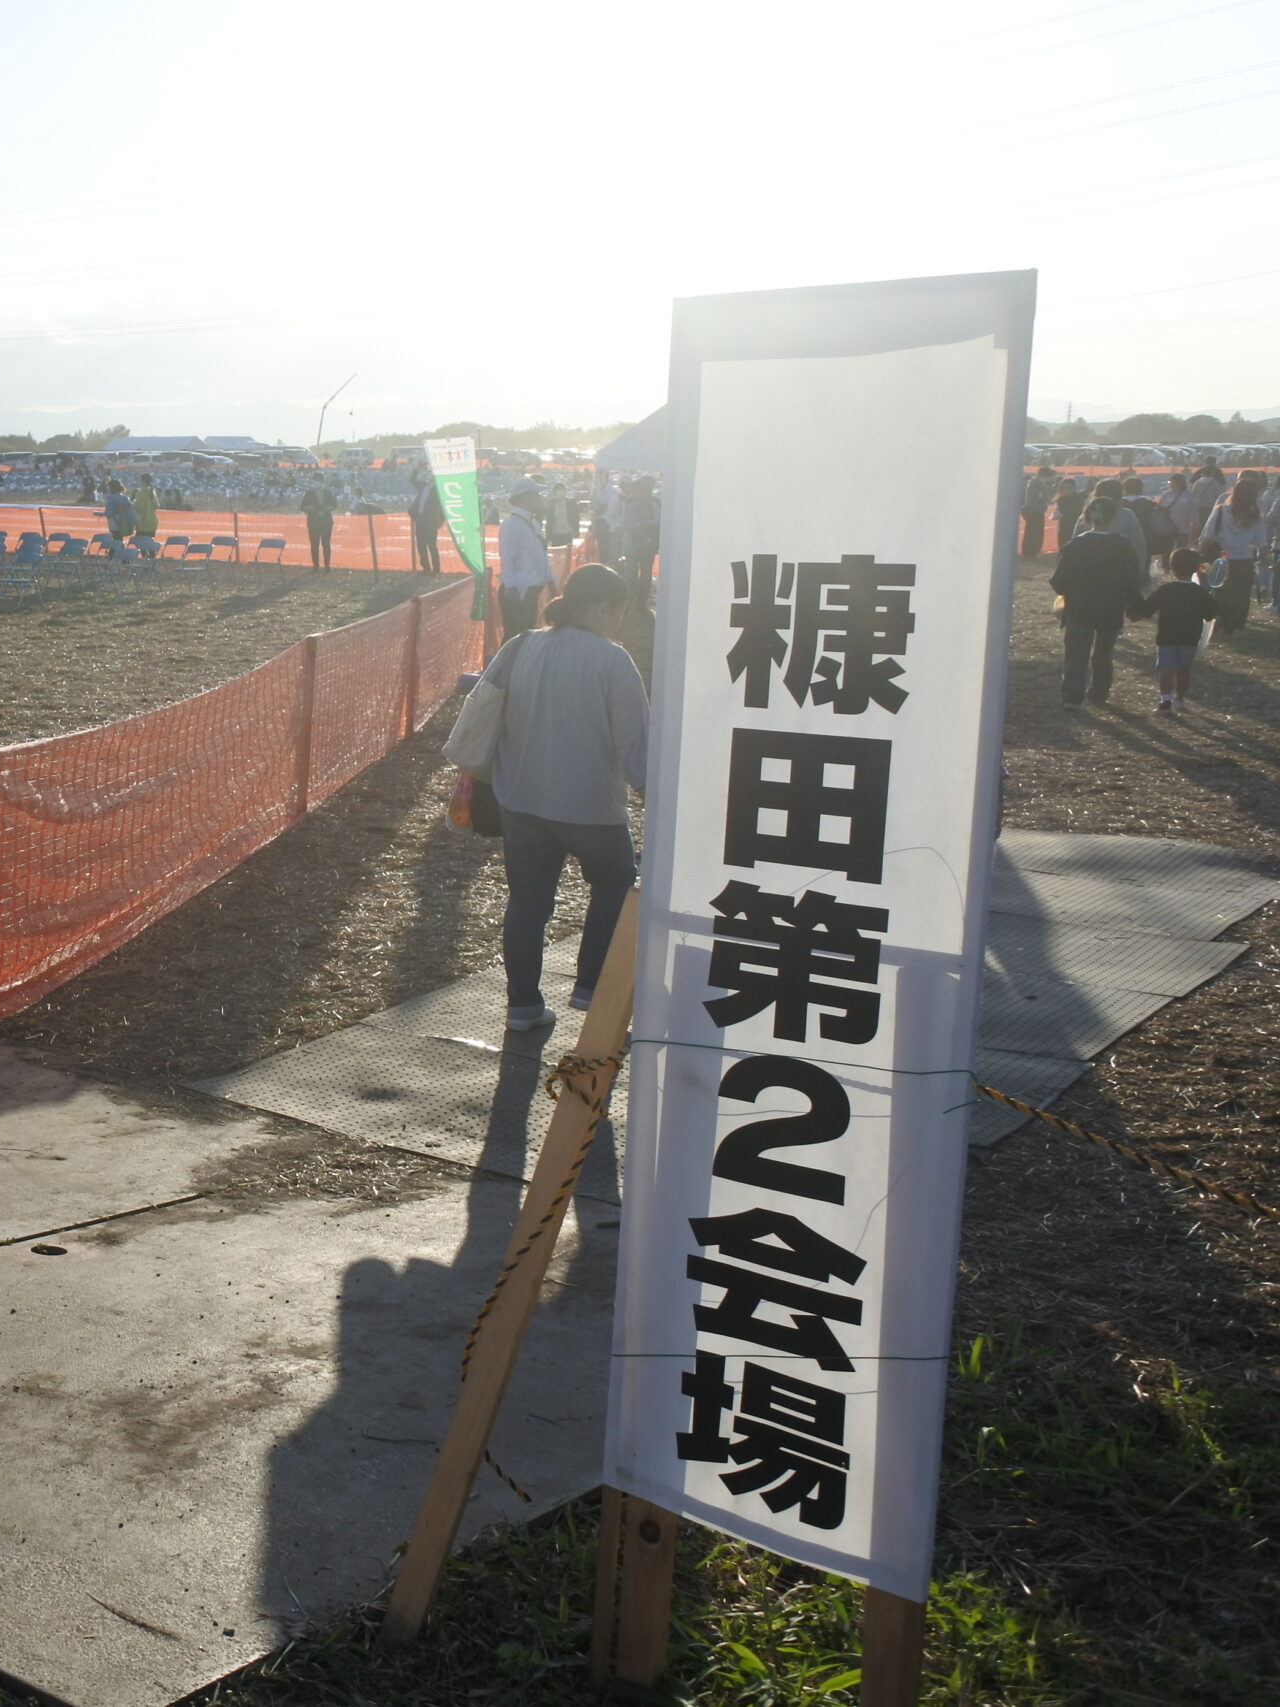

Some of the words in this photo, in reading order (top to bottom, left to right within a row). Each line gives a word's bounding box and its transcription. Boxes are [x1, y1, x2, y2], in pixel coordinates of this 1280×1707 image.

[676, 553, 917, 1530] 糠田第2会場
